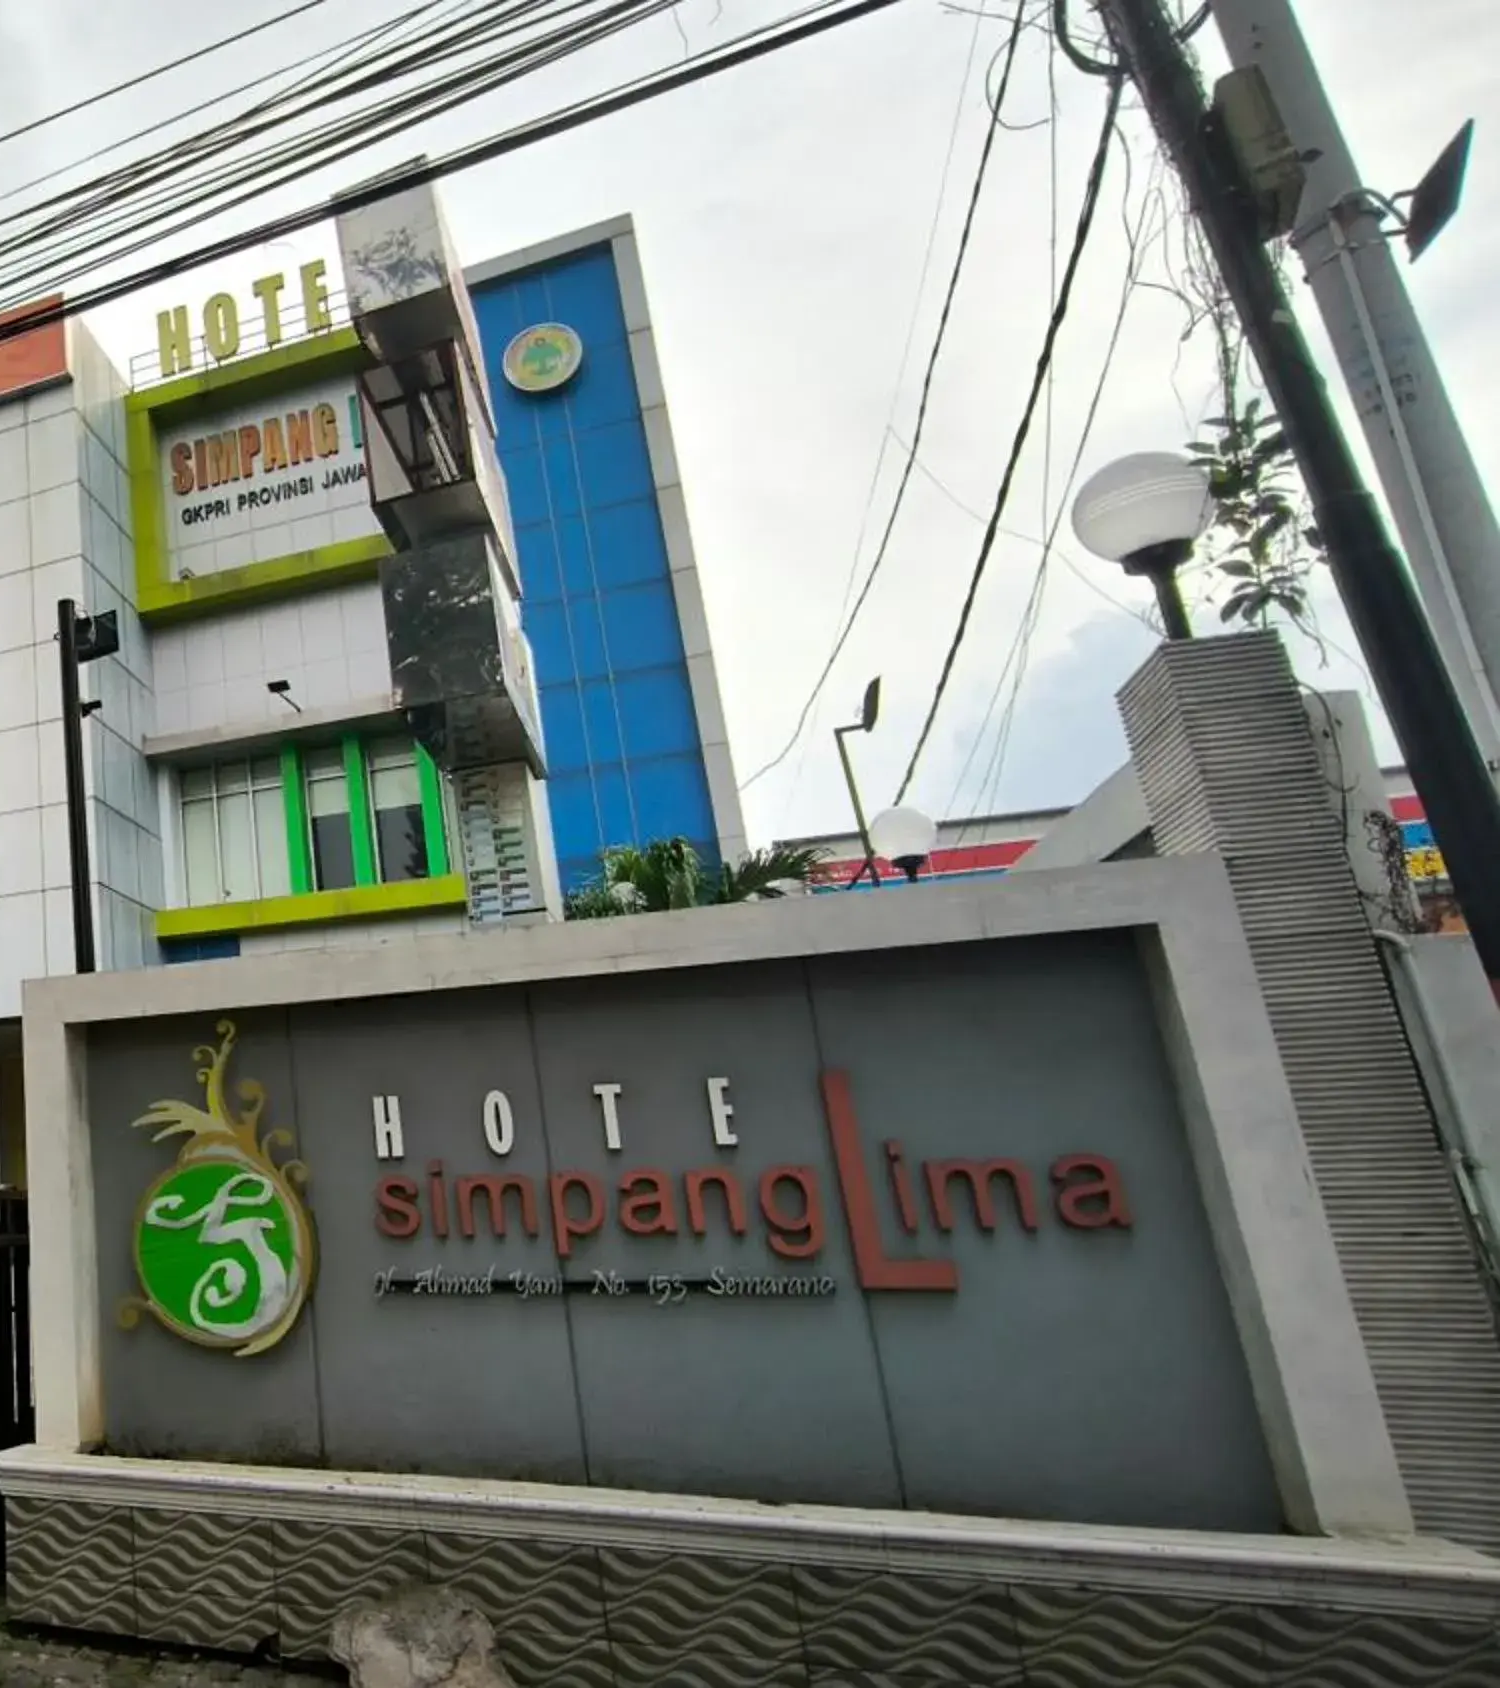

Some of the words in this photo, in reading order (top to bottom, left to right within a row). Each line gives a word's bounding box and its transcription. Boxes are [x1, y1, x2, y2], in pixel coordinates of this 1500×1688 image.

[156, 258, 333, 378] HOTE
[170, 402, 340, 497] SIMPANG
[237, 475, 314, 511] PROVINSI
[321, 462, 367, 490] JAWA
[372, 1076, 739, 1159] HOTE
[412, 1262, 497, 1295] Ahmad
[508, 1267, 565, 1299] Yani
[591, 1268, 630, 1296] No.
[647, 1271, 688, 1306] 153
